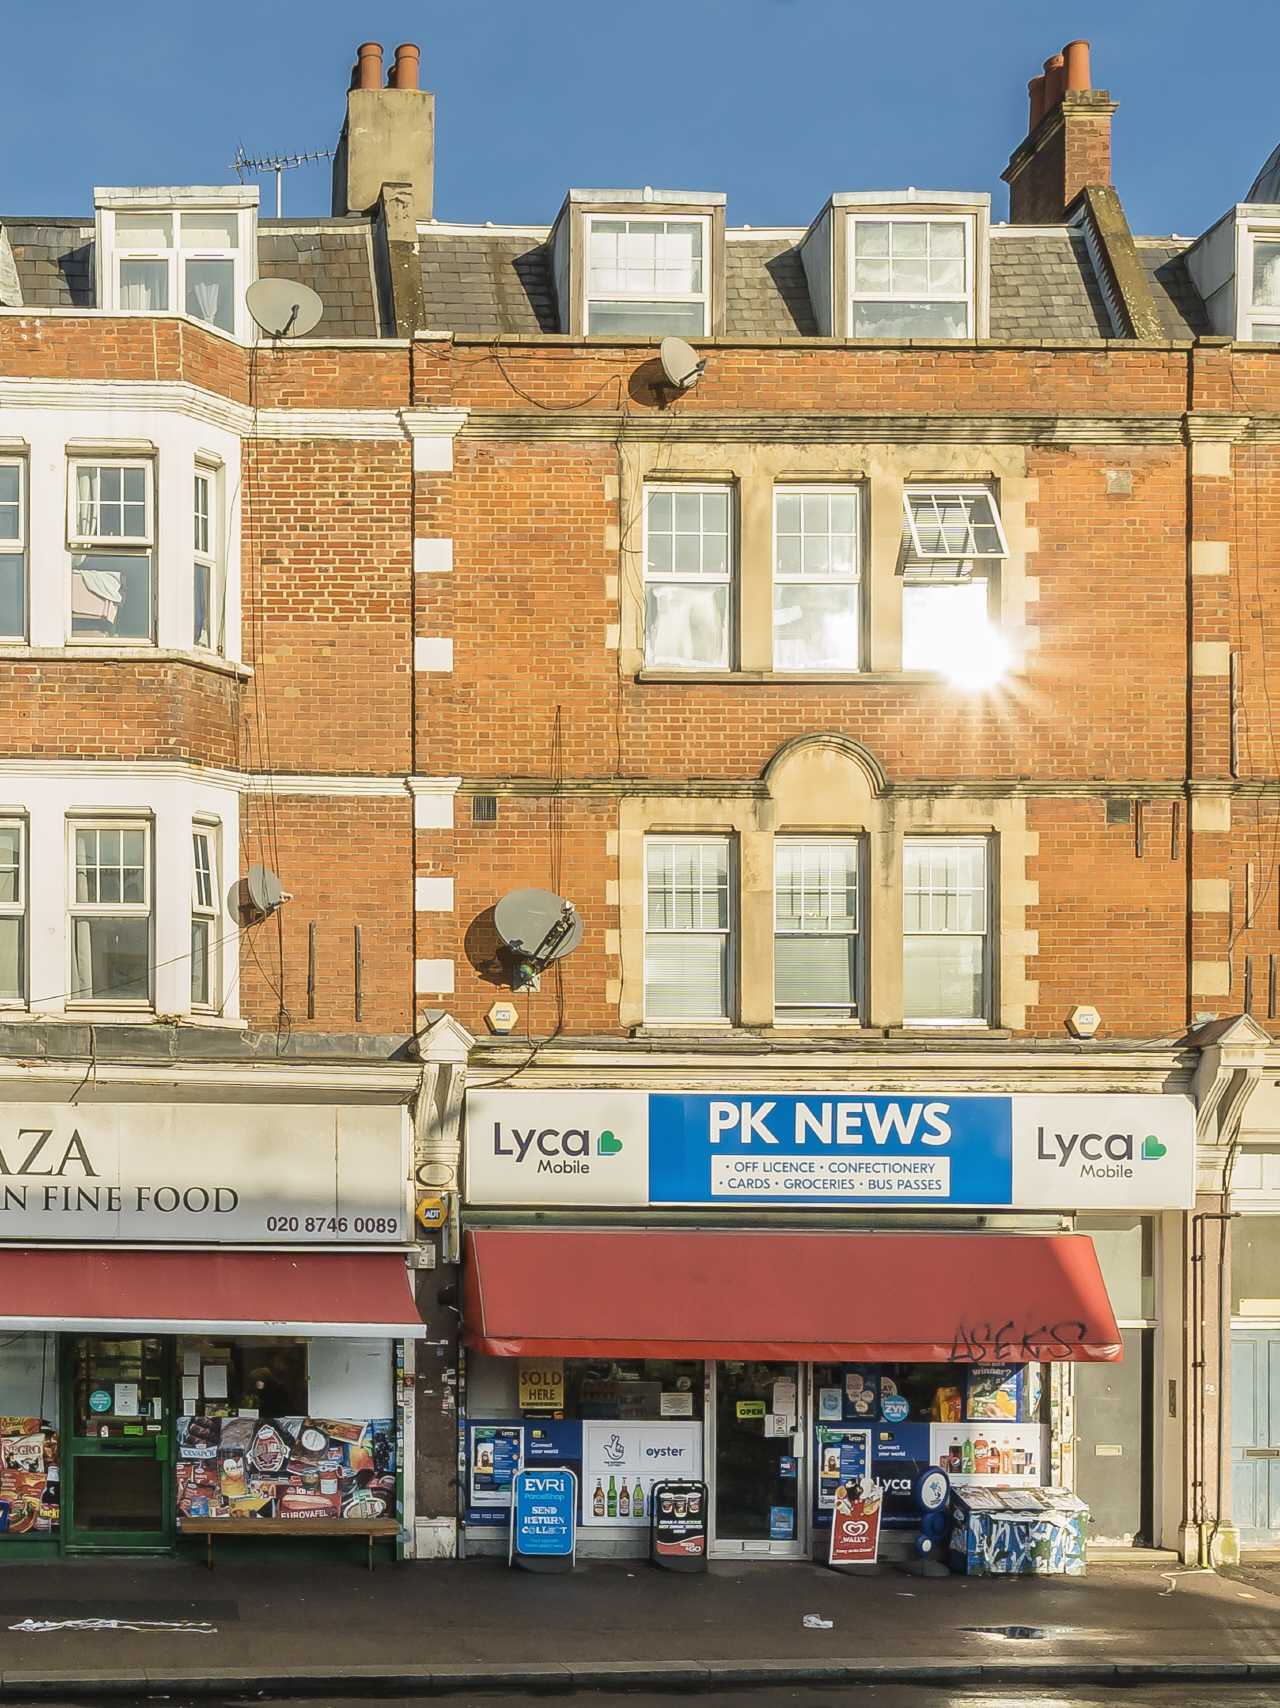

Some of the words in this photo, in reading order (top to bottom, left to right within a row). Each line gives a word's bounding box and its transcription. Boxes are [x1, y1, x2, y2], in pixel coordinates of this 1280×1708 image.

[709, 1101, 779, 1144] PK
[795, 1102, 952, 1146] NEWS
[493, 1121, 590, 1163] Lyca
[1038, 1126, 1134, 1167] Lyca
[536, 1159, 590, 1175] Mobile
[733, 1161, 759, 1173] OFF
[762, 1161, 815, 1173] LICENCE
[828, 1162, 936, 1175] CONFECTIONERY
[1080, 1163, 1134, 1179] Mobile
[727, 1178, 771, 1190] CARDS
[783, 1178, 855, 1190] GROCERIES
[868, 1178, 893, 1191] BUS
[896, 1179, 942, 1191] PASSES
[42, 1185, 122, 1212] FINE
[135, 1186, 239, 1213] FOOD
[424, 1209, 440, 1220] ADT
[266, 1215, 299, 1233] 020
[304, 1216, 348, 1234] 8746
[353, 1216, 398, 1234] 0089
[521, 1371, 562, 1386] SOLD
[528, 1388, 555, 1401] HERE
[739, 1408, 763, 1416] OPEN
[646, 1446, 686, 1459] oyster
[874, 1476, 911, 1492] Lyca
[531, 1506, 558, 1515] SEND
[524, 1516, 565, 1524] RETURN
[521, 1526, 567, 1534] COLLECT
